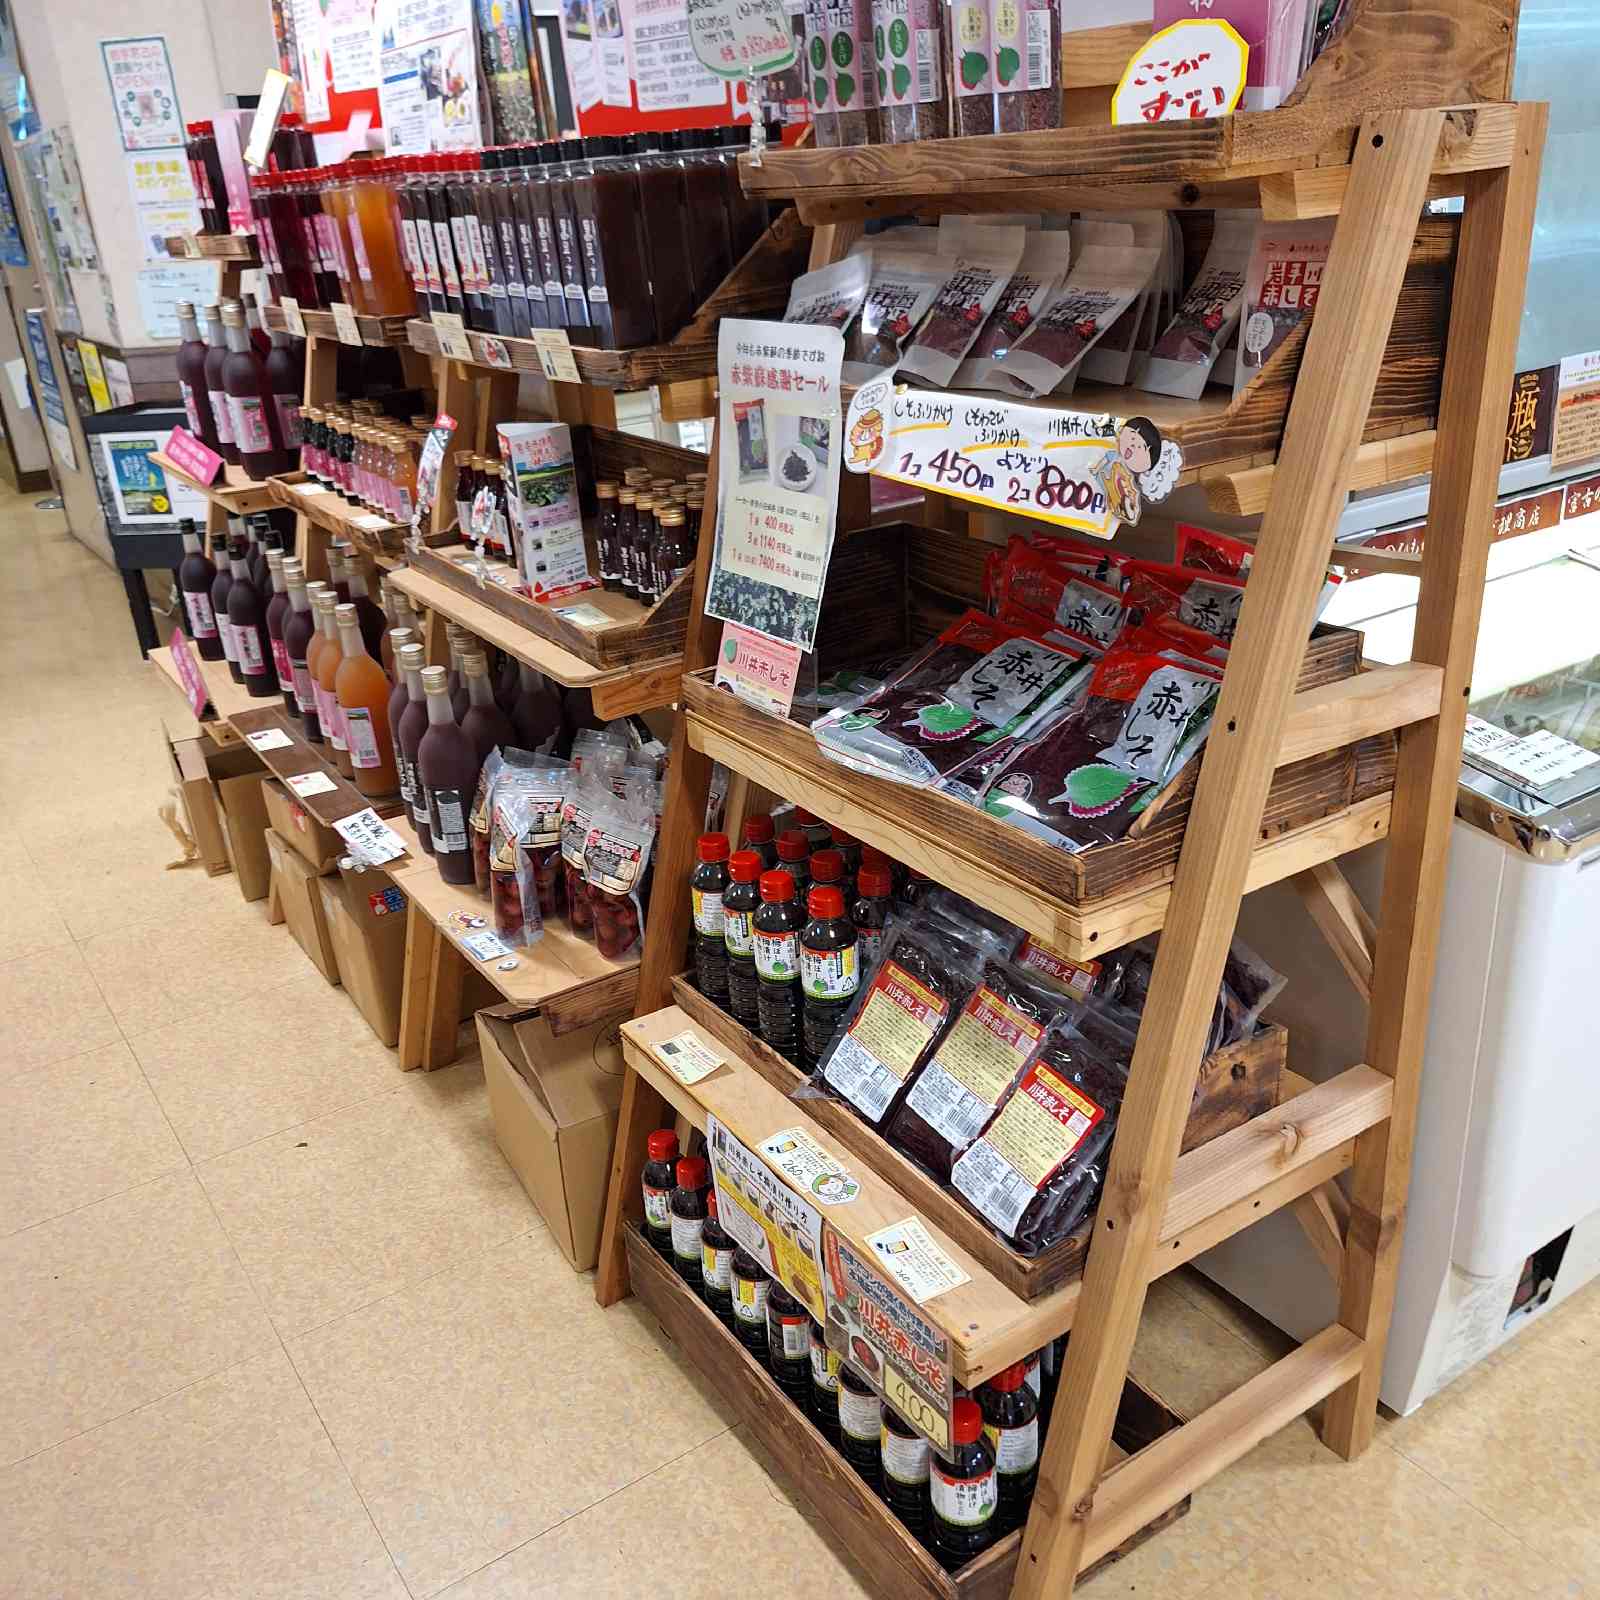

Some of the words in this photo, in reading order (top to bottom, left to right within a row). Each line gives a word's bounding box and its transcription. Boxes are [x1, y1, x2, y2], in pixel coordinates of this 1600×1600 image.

[1134, 53, 1211, 86] ここが
[738, 652, 791, 688] 川井赤しそ
[895, 1381, 936, 1433] 400
